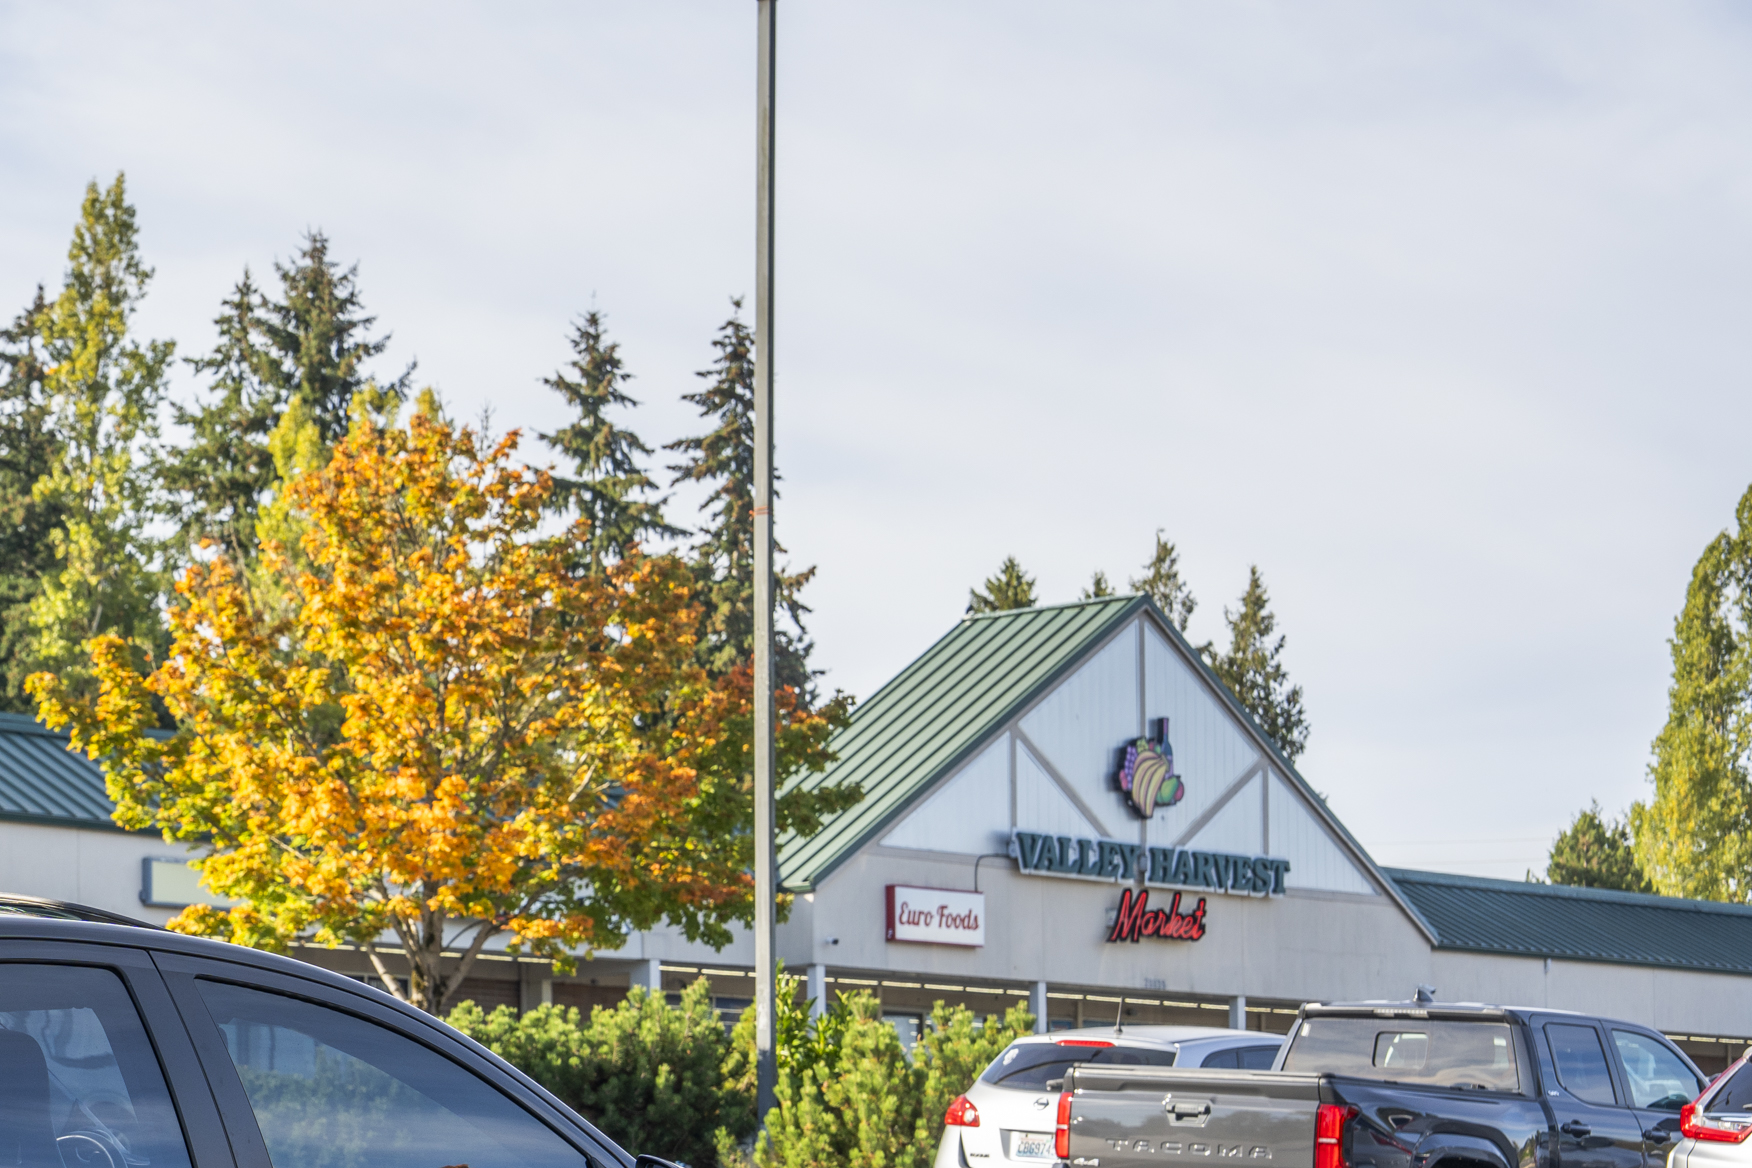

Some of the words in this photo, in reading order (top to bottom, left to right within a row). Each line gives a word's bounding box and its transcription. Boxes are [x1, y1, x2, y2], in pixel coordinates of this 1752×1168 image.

[1016, 832, 1141, 880] VALLEY
[1149, 847, 1291, 895] HARVEST
[899, 902, 934, 928] Euro
[937, 905, 980, 931] Foods
[1110, 889, 1207, 943] Market
[1106, 1136, 1273, 1160] TACOMA
